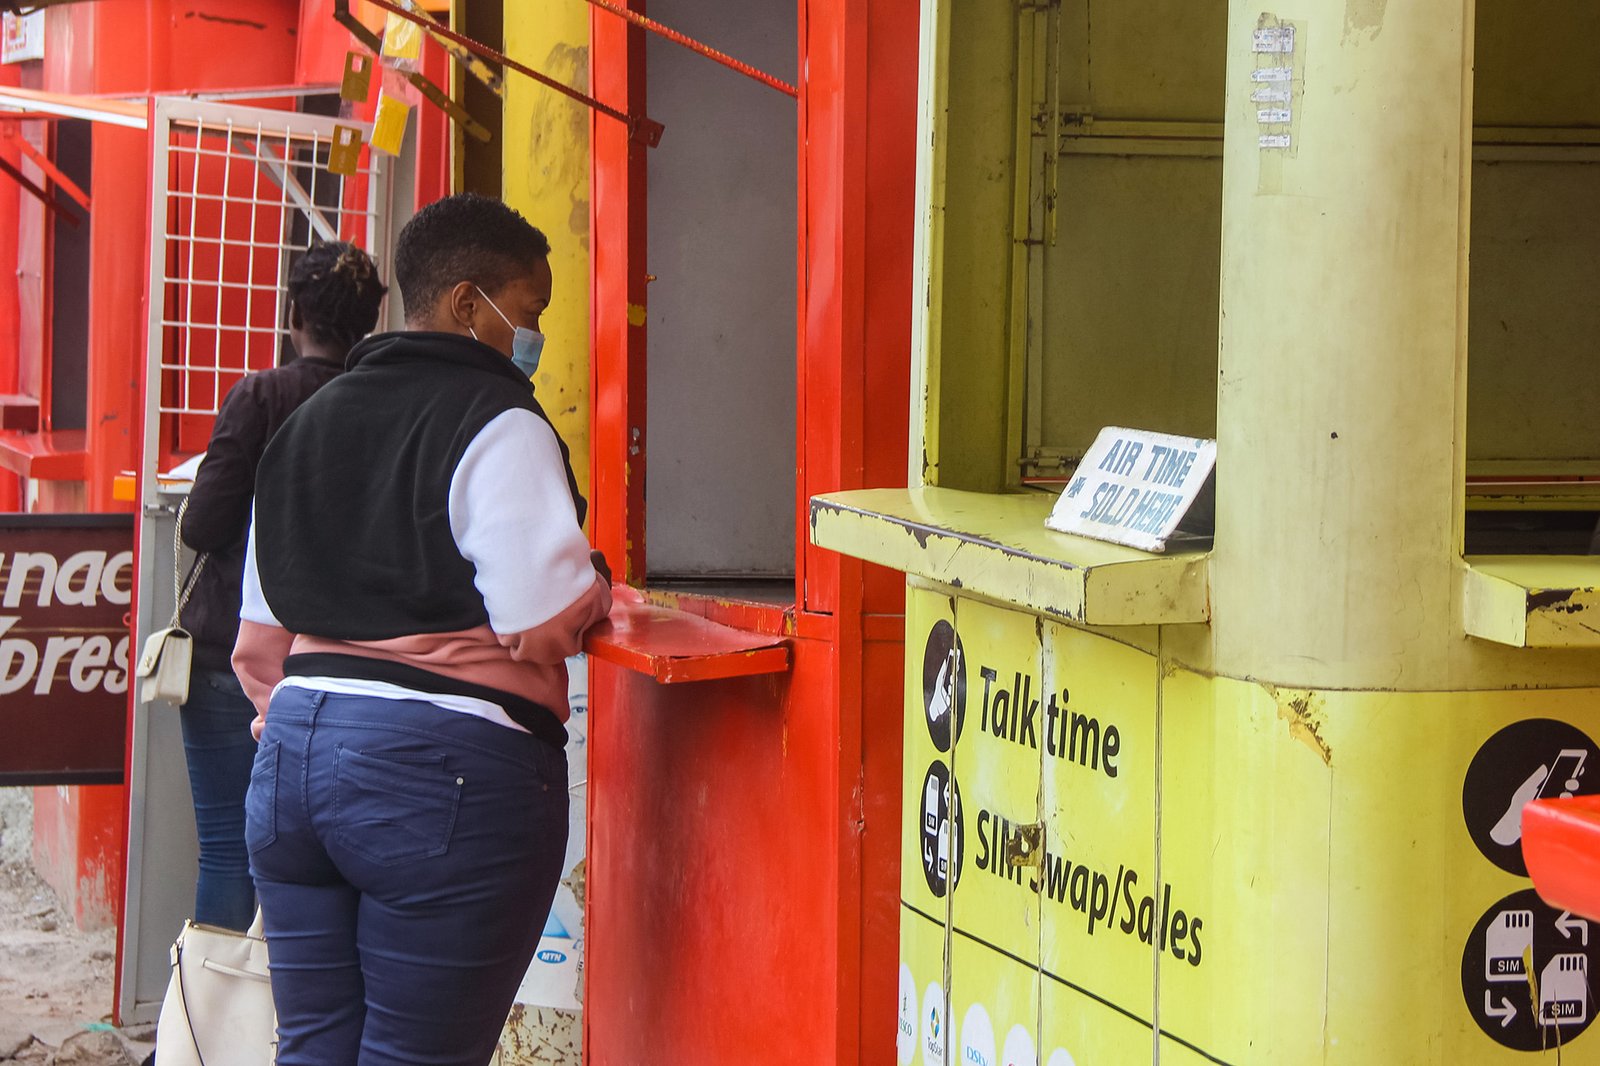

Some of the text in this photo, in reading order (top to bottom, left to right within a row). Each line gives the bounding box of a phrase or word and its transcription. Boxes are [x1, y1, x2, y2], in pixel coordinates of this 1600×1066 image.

[1099, 439, 1197, 488] AIR TIME
[1080, 481, 1184, 536] SOLD HERE
[980, 665, 1121, 778] Talk time
[975, 808, 1022, 886] SIM
[541, 951, 562, 962] MTN
[1498, 960, 1519, 972] SIM
[1551, 1003, 1575, 1015] SIM
